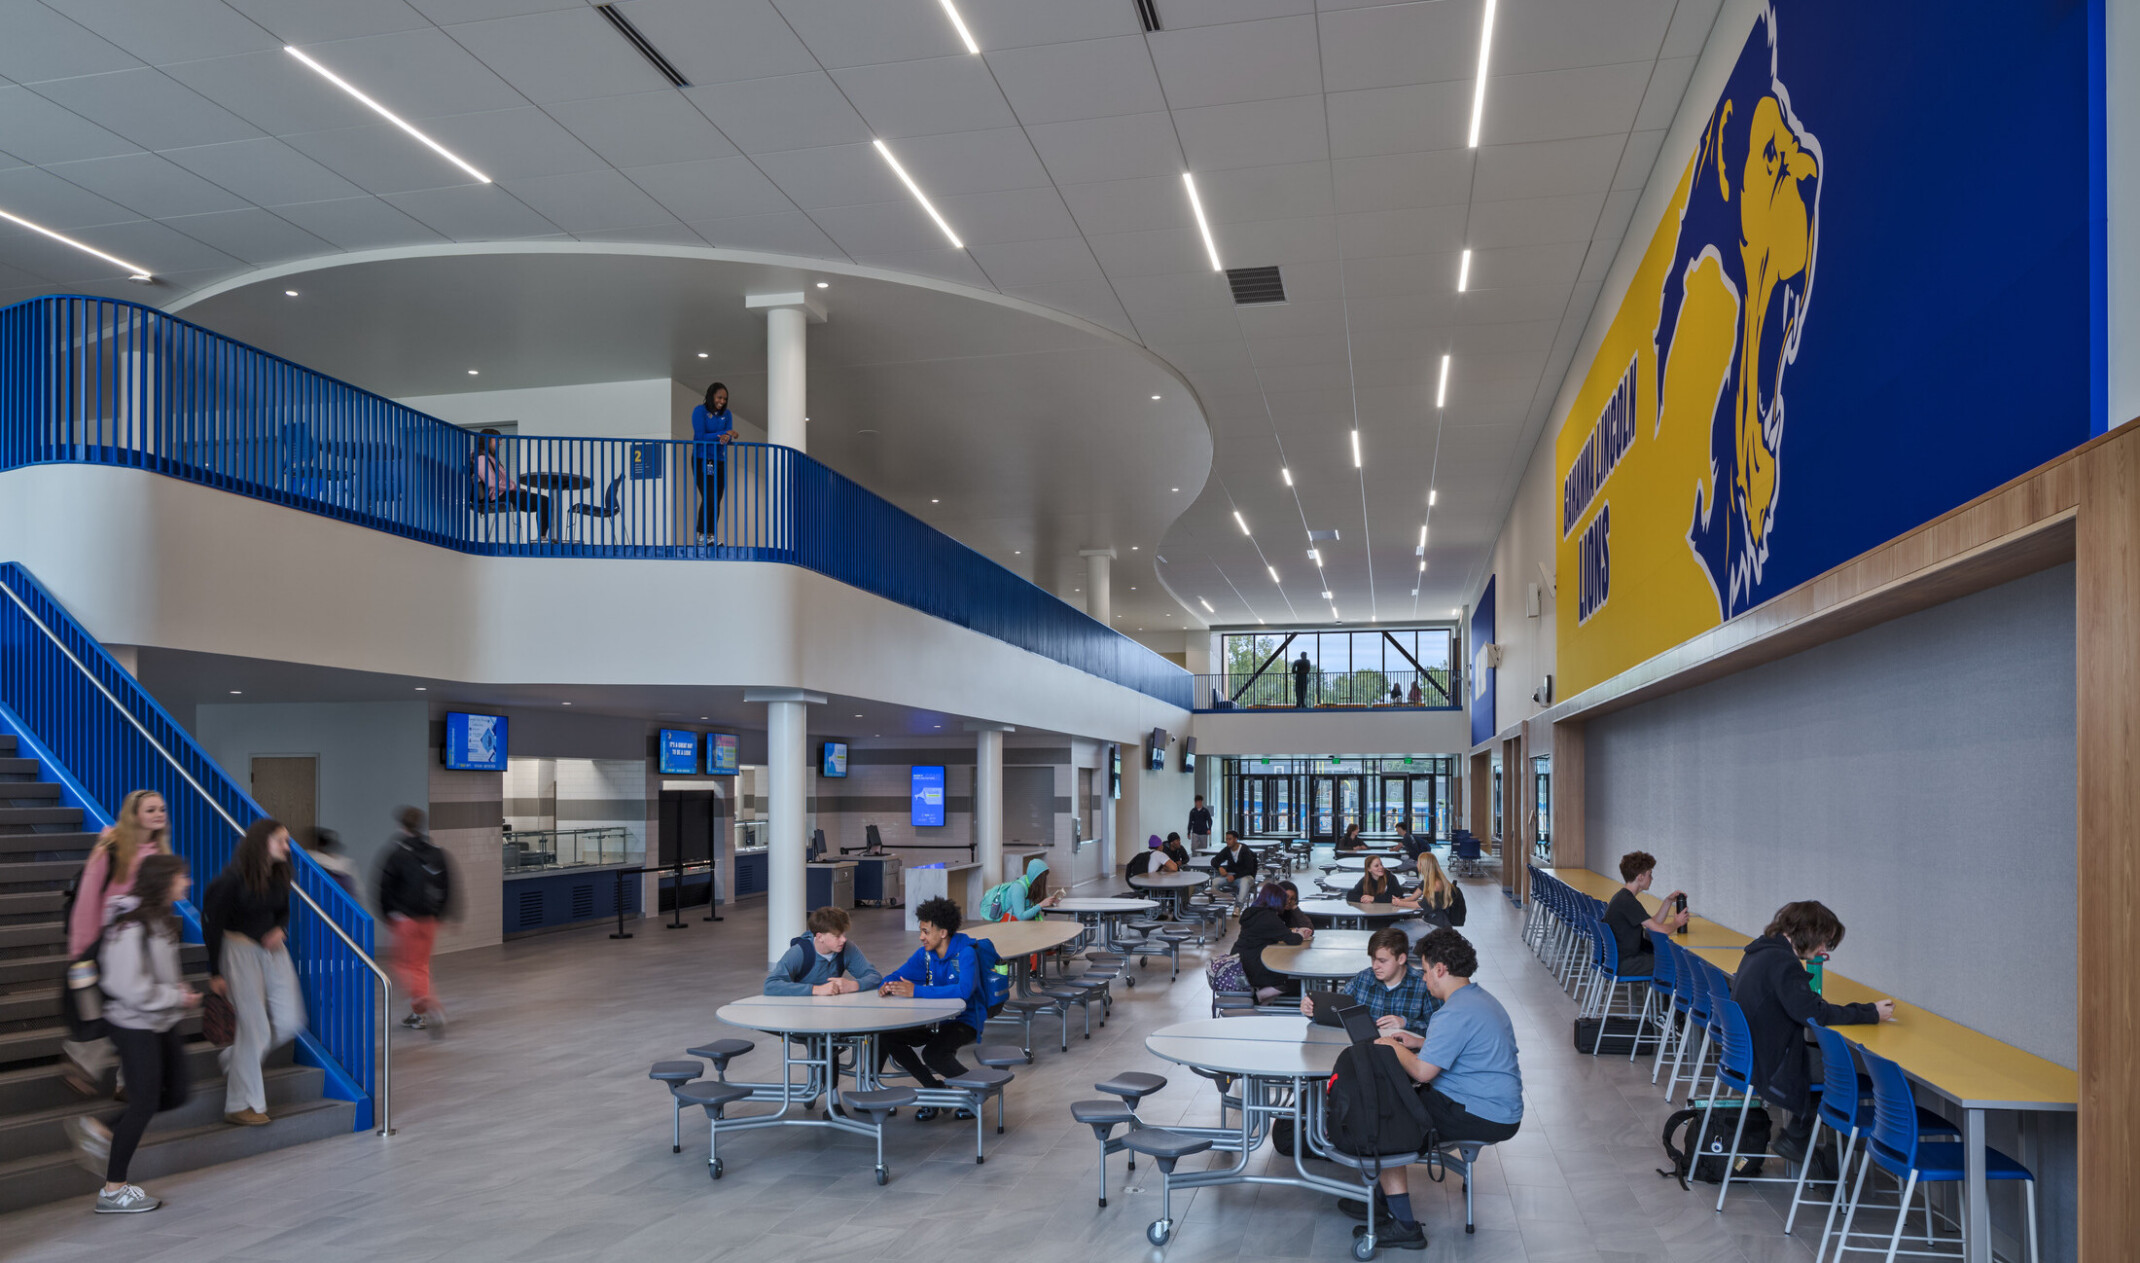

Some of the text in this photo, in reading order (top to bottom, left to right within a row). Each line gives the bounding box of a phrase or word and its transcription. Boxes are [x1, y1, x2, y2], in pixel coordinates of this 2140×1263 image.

[634, 450, 642, 463] 2
[1563, 351, 1638, 541] GAHANNA LINCOLN
[1578, 499, 1610, 626] LIONS
[116, 1194, 134, 1208] N
